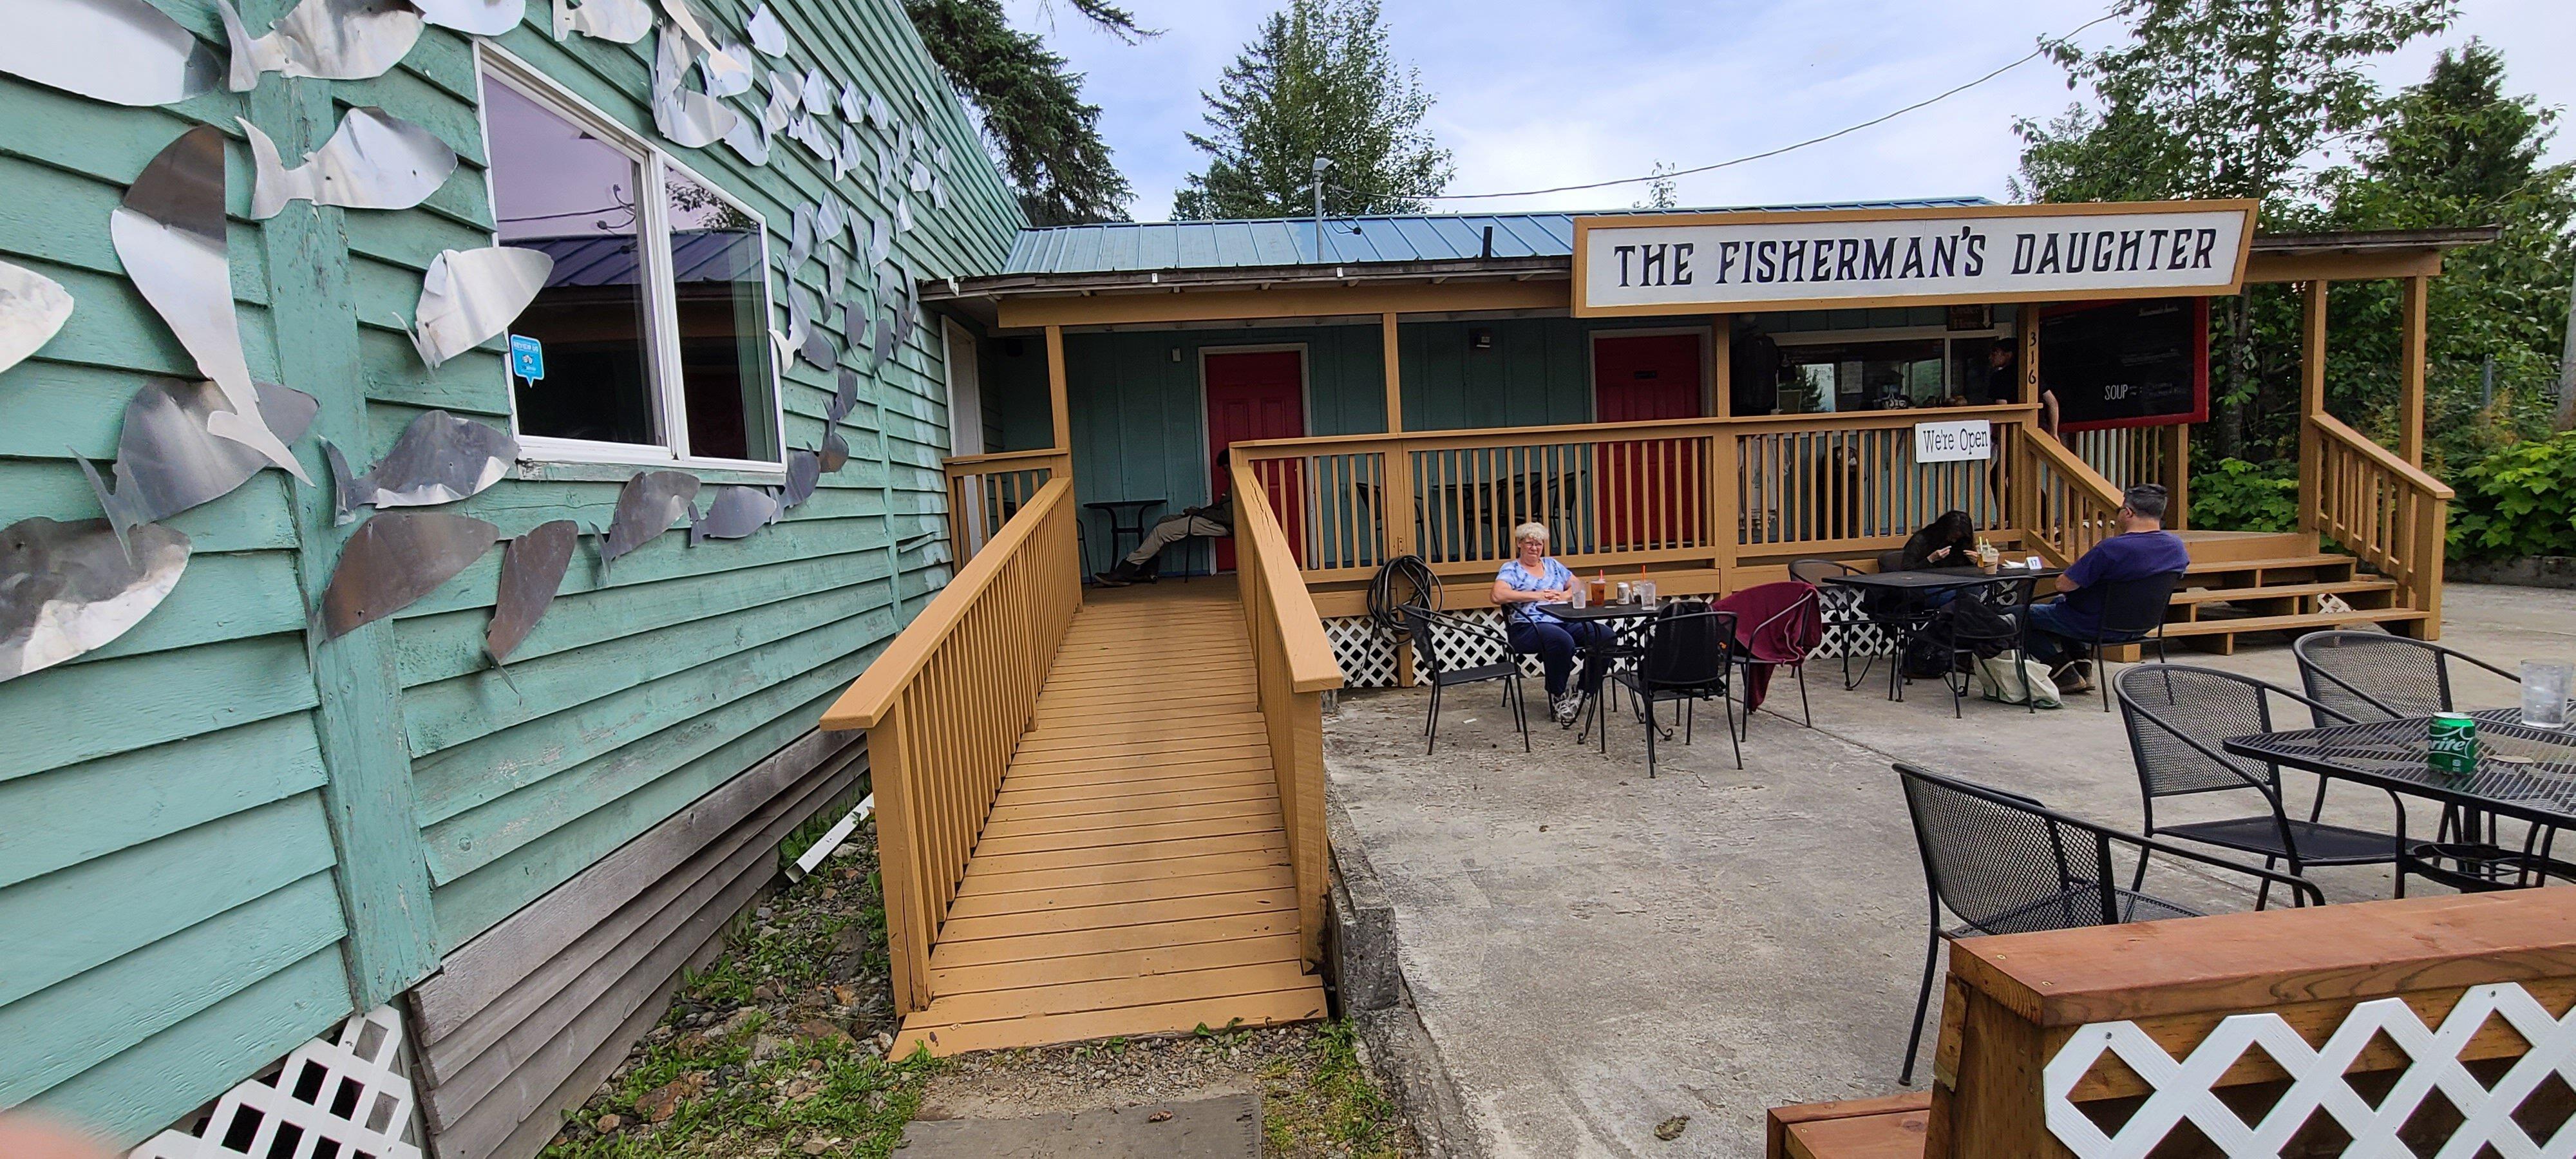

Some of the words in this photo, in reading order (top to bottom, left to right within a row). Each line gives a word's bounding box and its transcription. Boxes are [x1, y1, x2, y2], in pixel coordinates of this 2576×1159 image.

[1614, 242, 1694, 287] THE
[1714, 225, 1986, 285] FISHERMAN'S
[2011, 228, 2217, 275] DAUGHTER
[2105, 384, 2128, 400] SOUP
[1923, 429, 1955, 453] We're
[1960, 428, 1988, 455] Open
